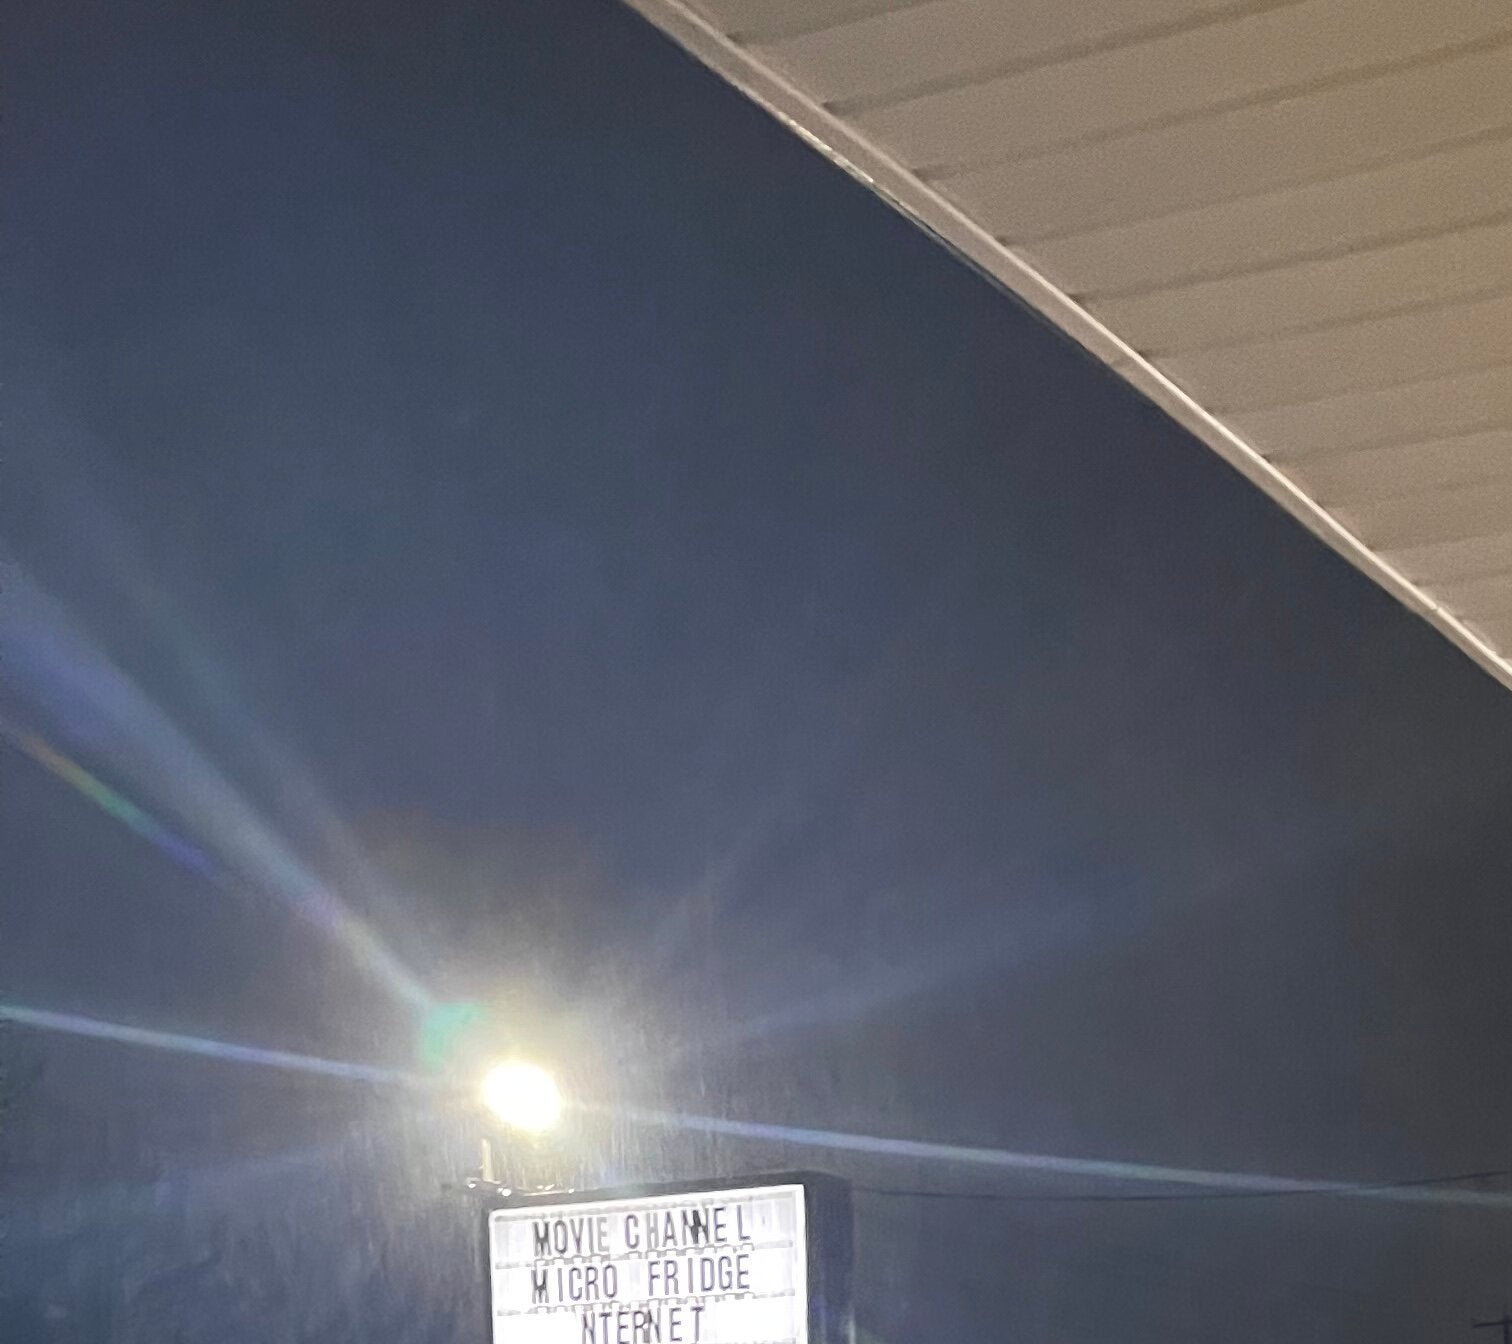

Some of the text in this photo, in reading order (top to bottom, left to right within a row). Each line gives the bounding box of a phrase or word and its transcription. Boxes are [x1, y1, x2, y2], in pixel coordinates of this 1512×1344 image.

[532, 1205, 751, 1257] MOVIE CHANNEL
[531, 1254, 750, 1304] MICRO FRIDGE
